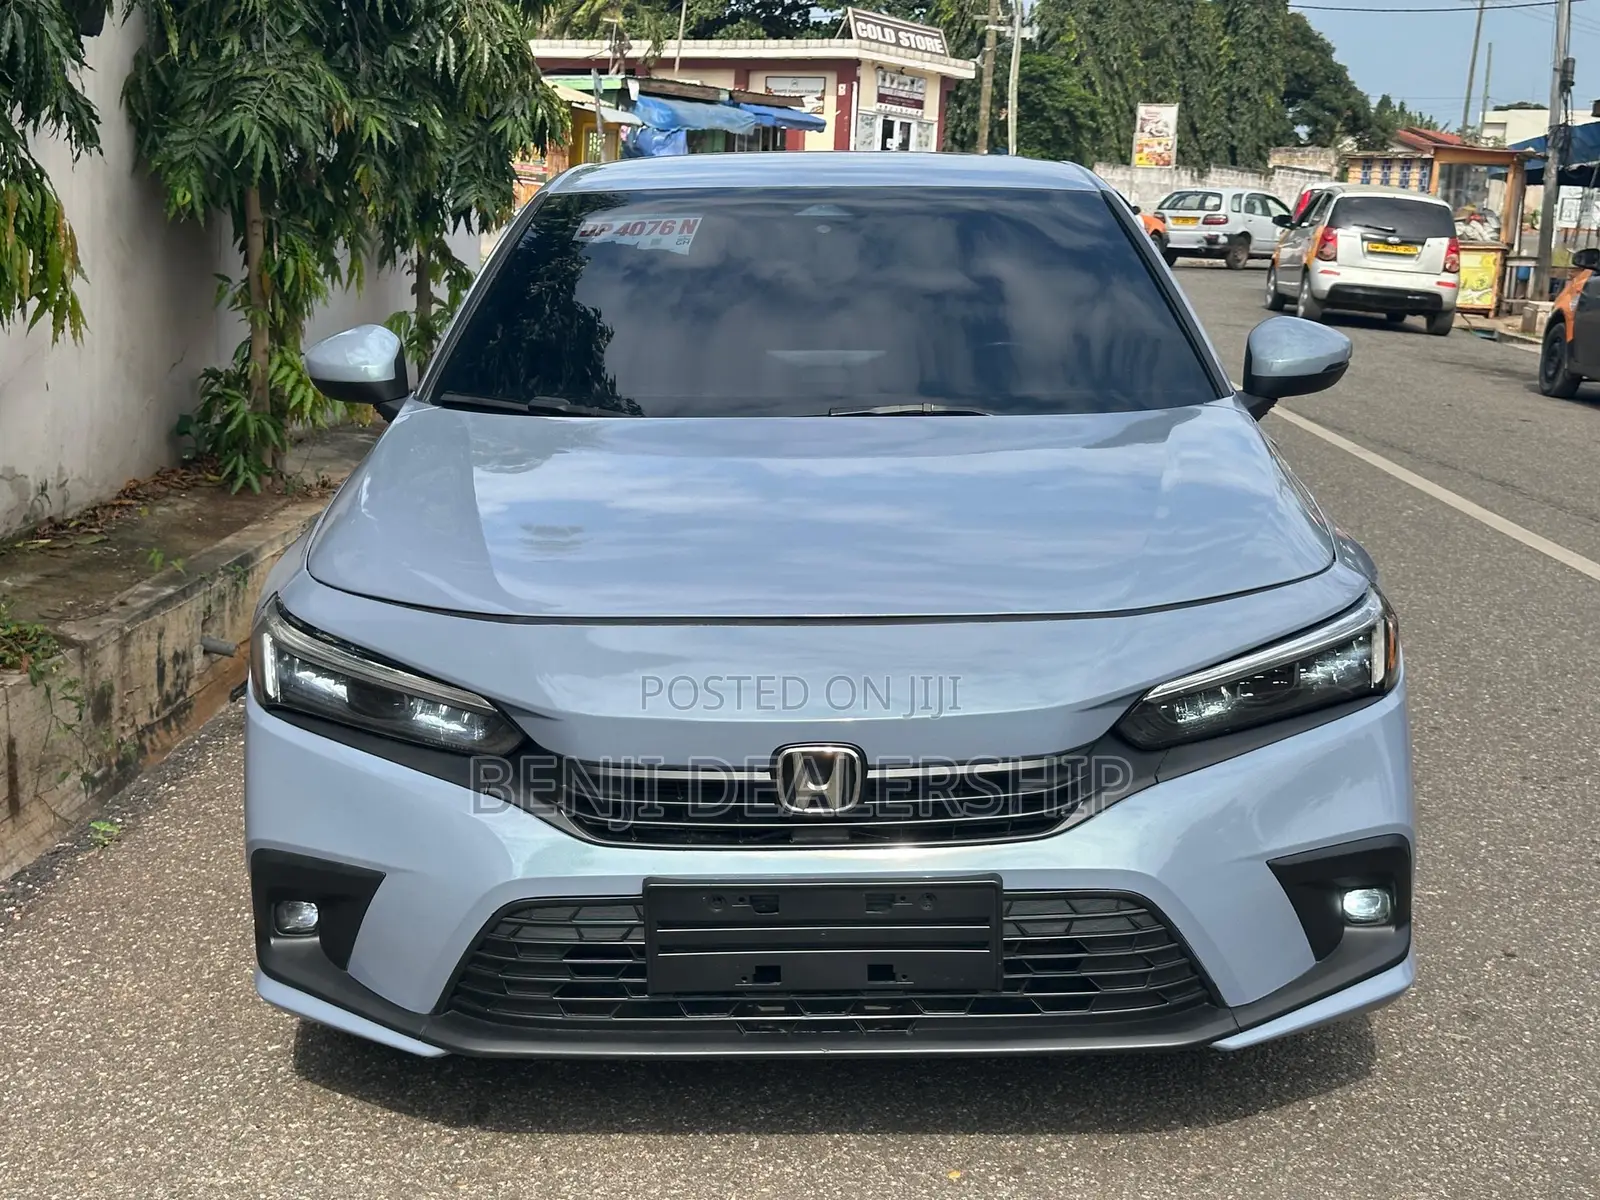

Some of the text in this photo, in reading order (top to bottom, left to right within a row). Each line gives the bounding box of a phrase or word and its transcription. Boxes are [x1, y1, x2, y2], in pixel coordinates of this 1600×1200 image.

[856, 21, 945, 54] COLD STORE
[613, 219, 677, 237] 4076
[679, 219, 699, 235] N
